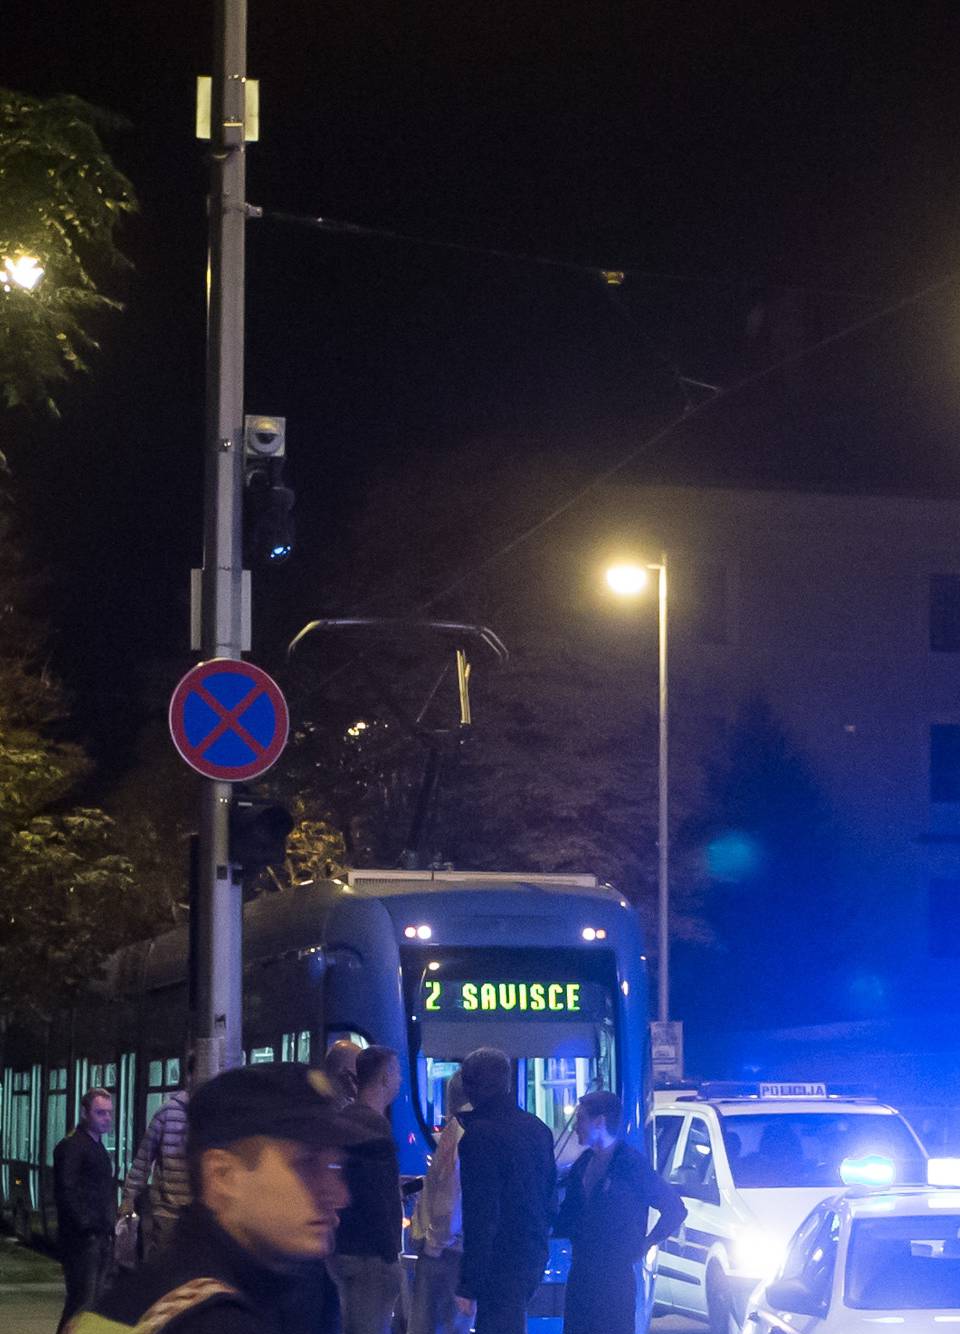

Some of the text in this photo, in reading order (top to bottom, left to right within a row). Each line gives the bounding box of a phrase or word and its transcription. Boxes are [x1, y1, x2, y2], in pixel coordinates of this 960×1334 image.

[425, 980, 581, 1012] 2 SAVISCE
[762, 1085, 825, 1097] POLICIJA
